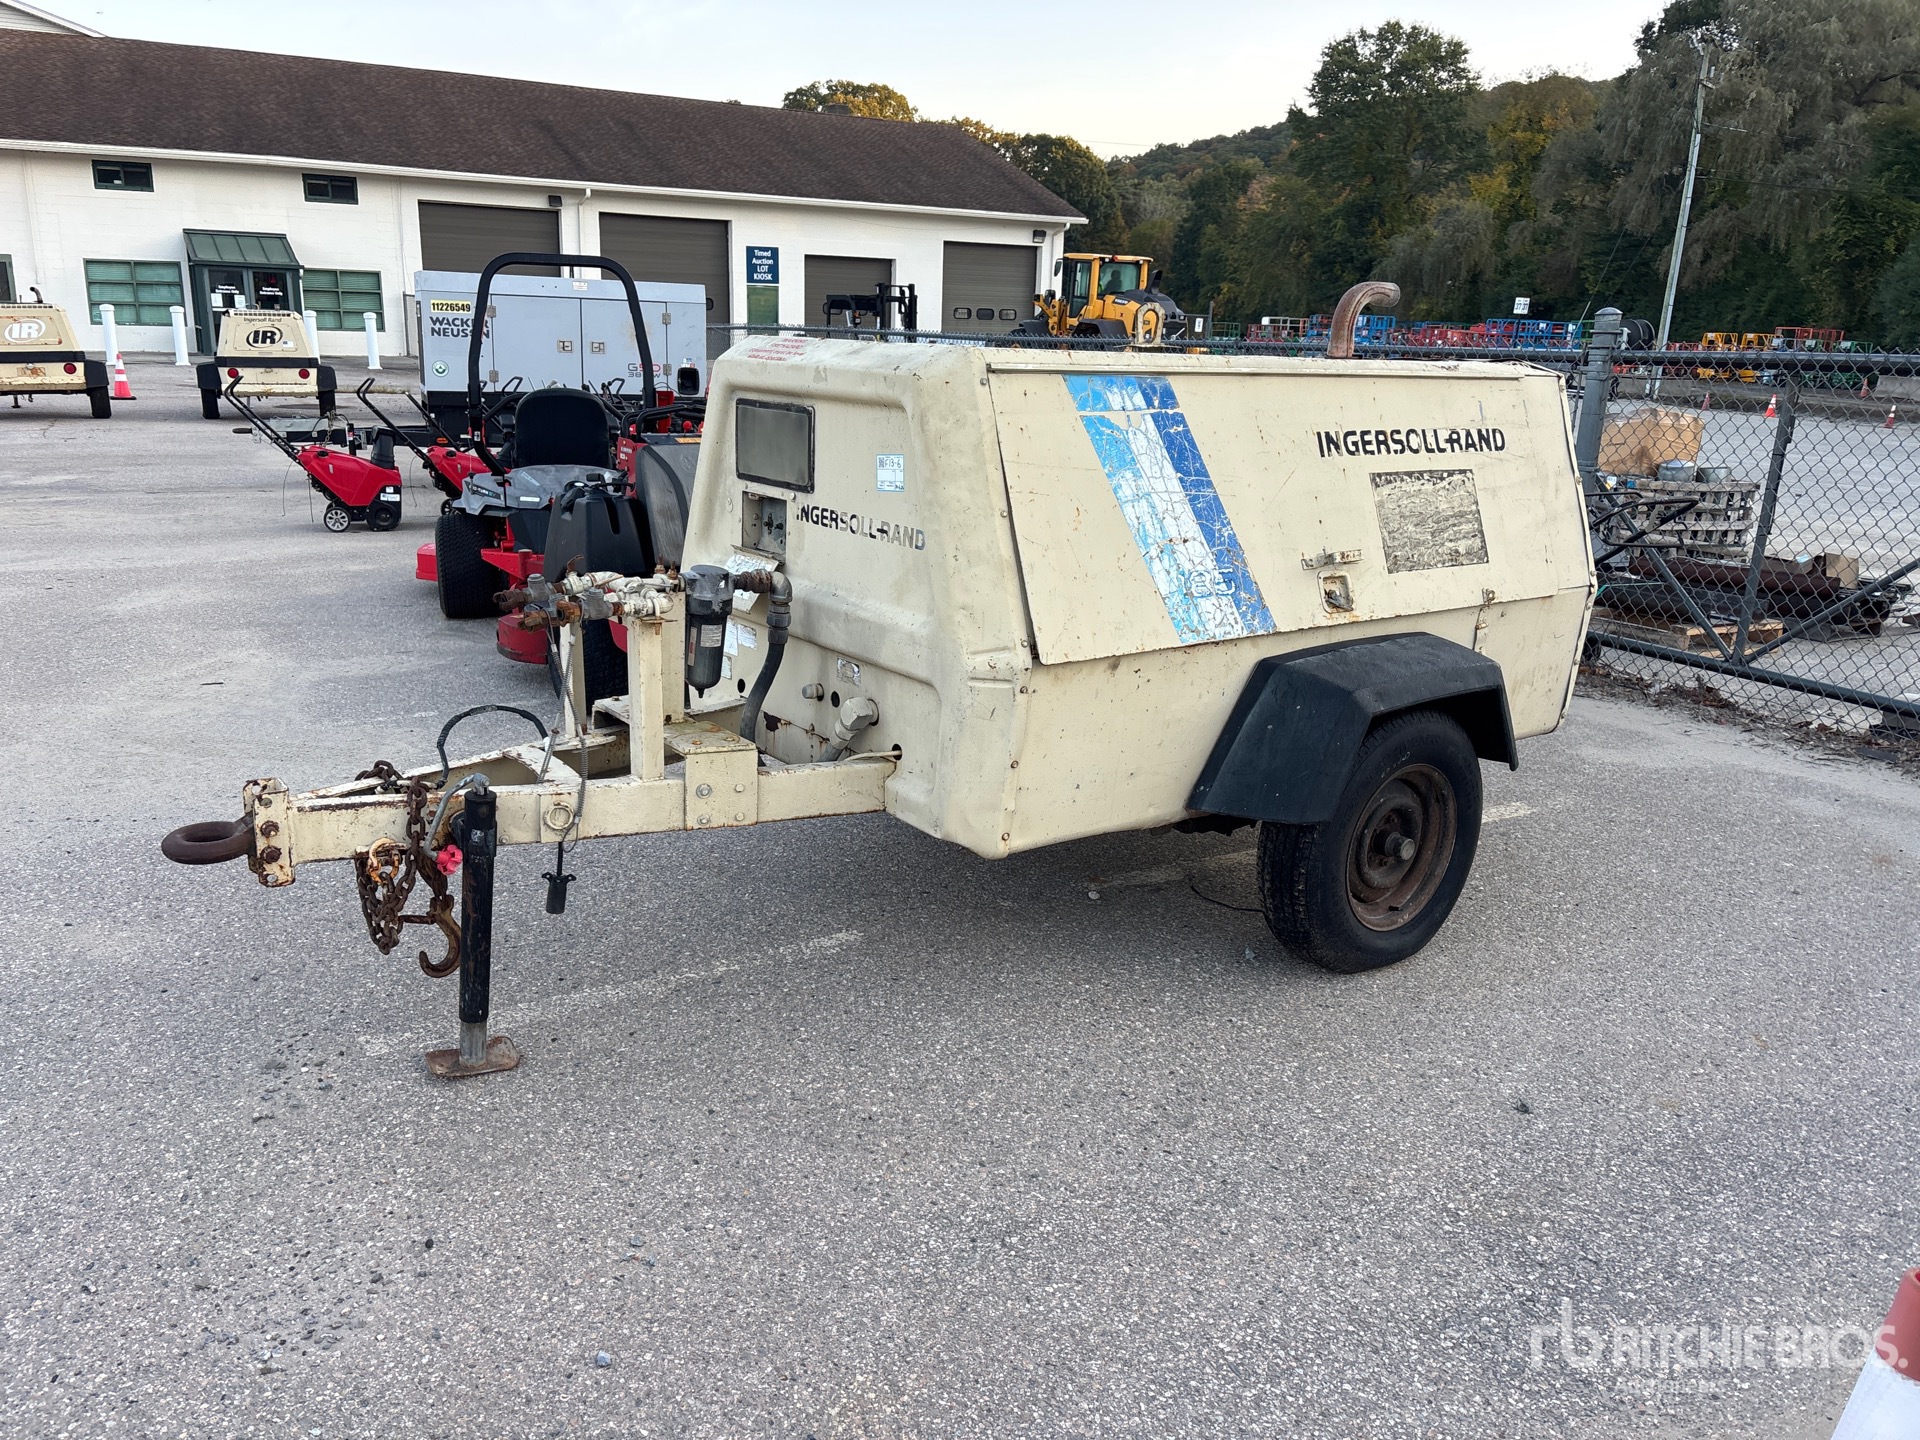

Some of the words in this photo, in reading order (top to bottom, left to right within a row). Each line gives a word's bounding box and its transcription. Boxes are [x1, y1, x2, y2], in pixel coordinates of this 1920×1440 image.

[431, 302, 471, 312] 11226549
[429, 316, 489, 329] WACKR
[1315, 428, 1506, 457] INGERSOLL-RAND
